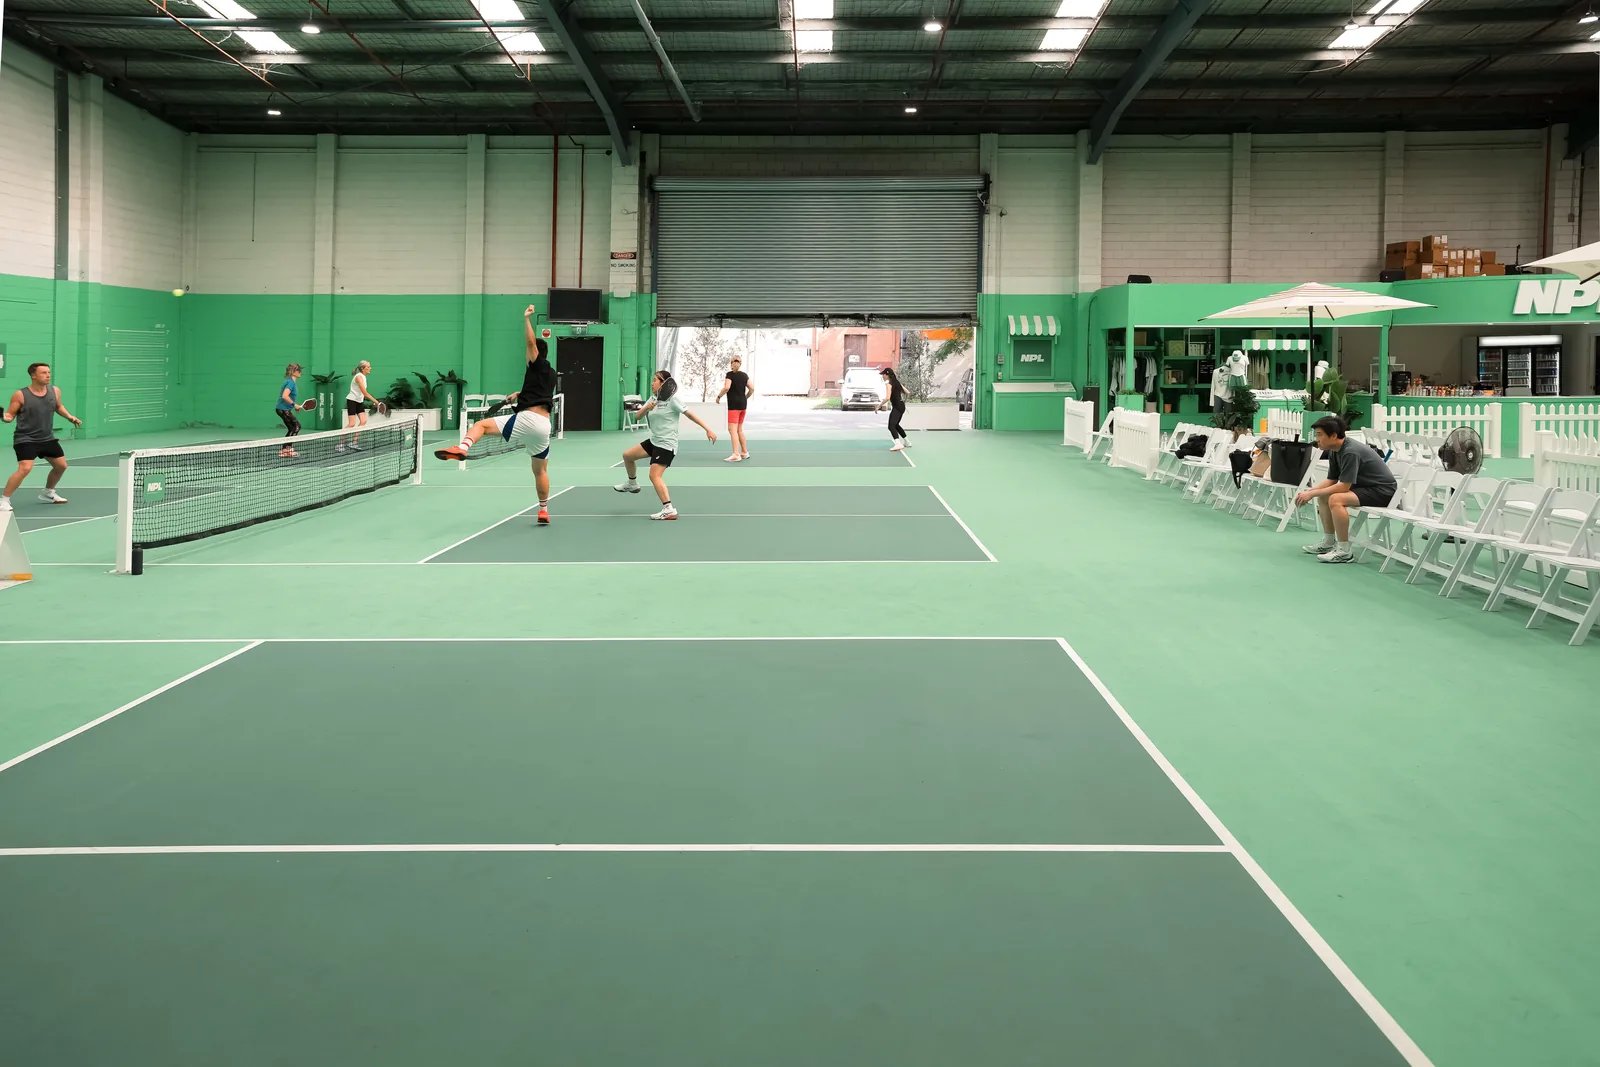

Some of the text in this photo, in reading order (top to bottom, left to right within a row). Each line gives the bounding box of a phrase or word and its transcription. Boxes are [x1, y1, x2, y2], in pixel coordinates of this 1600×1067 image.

[1512, 279, 1600, 314] NP
[1020, 354, 1044, 362] NPL
[147, 482, 162, 492] NPL
